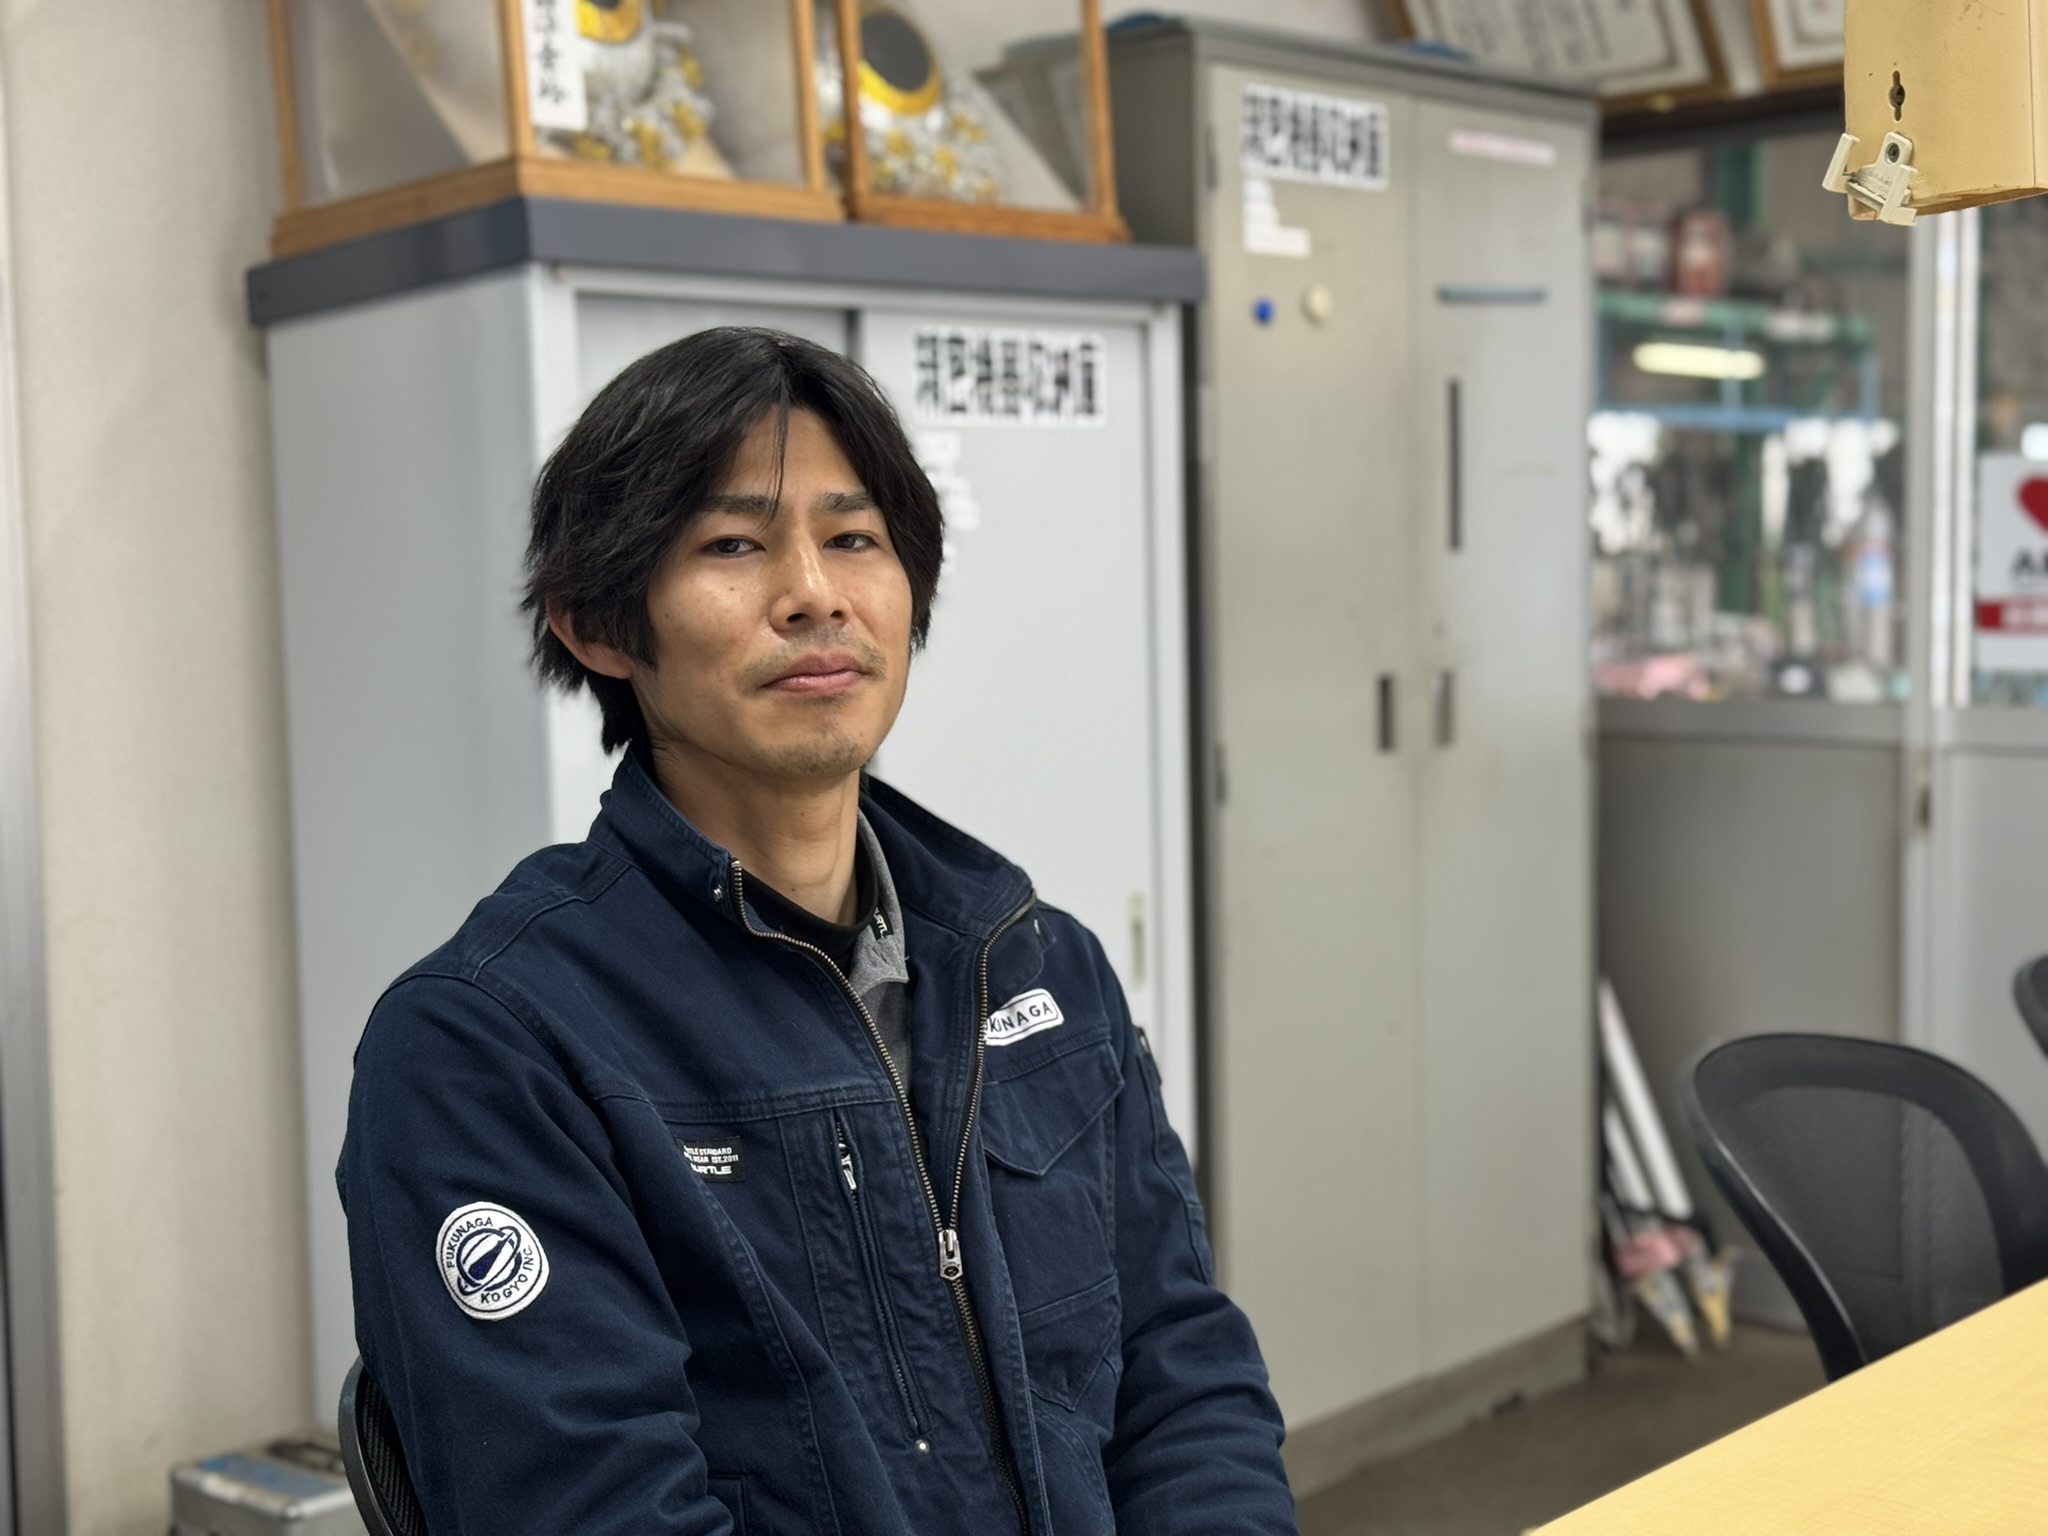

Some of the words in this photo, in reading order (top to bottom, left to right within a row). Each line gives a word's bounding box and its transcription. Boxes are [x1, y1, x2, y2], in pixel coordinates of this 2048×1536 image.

[699, 1147, 732, 1156] STANDARD
[690, 1162, 732, 1175] URTLE
[445, 1216, 494, 1269] FUKUNAGA
[480, 1273, 528, 1304] KOGYO
